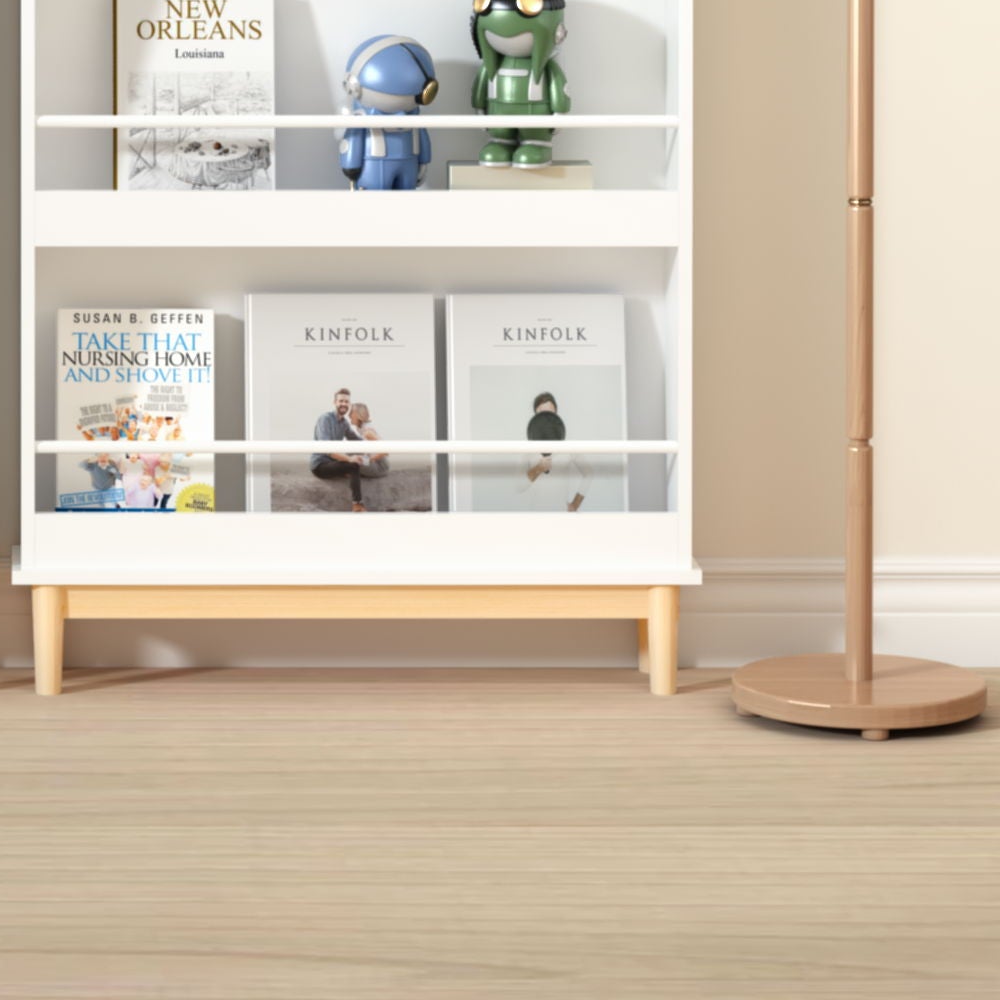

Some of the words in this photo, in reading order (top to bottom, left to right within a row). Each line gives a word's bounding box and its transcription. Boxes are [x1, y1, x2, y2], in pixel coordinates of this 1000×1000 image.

[165, 0, 227, 19] NEW
[136, 20, 262, 40] ORLEANS
[174, 48, 225, 59] Louisiana
[73, 312, 122, 324] SUSAN
[129, 313, 143, 324] B.
[150, 313, 204, 324] GEFFEN
[72, 332, 130, 351] TAKE
[137, 332, 202, 351] THAT
[304, 327, 394, 341] KINFOLK
[503, 327, 587, 341] KINFOLK
[62, 351, 149, 366] NURSING
[155, 351, 212, 366] HOME
[63, 367, 111, 383] AND
[115, 367, 182, 383] SHOVE
[187, 367, 211, 383] IT!
